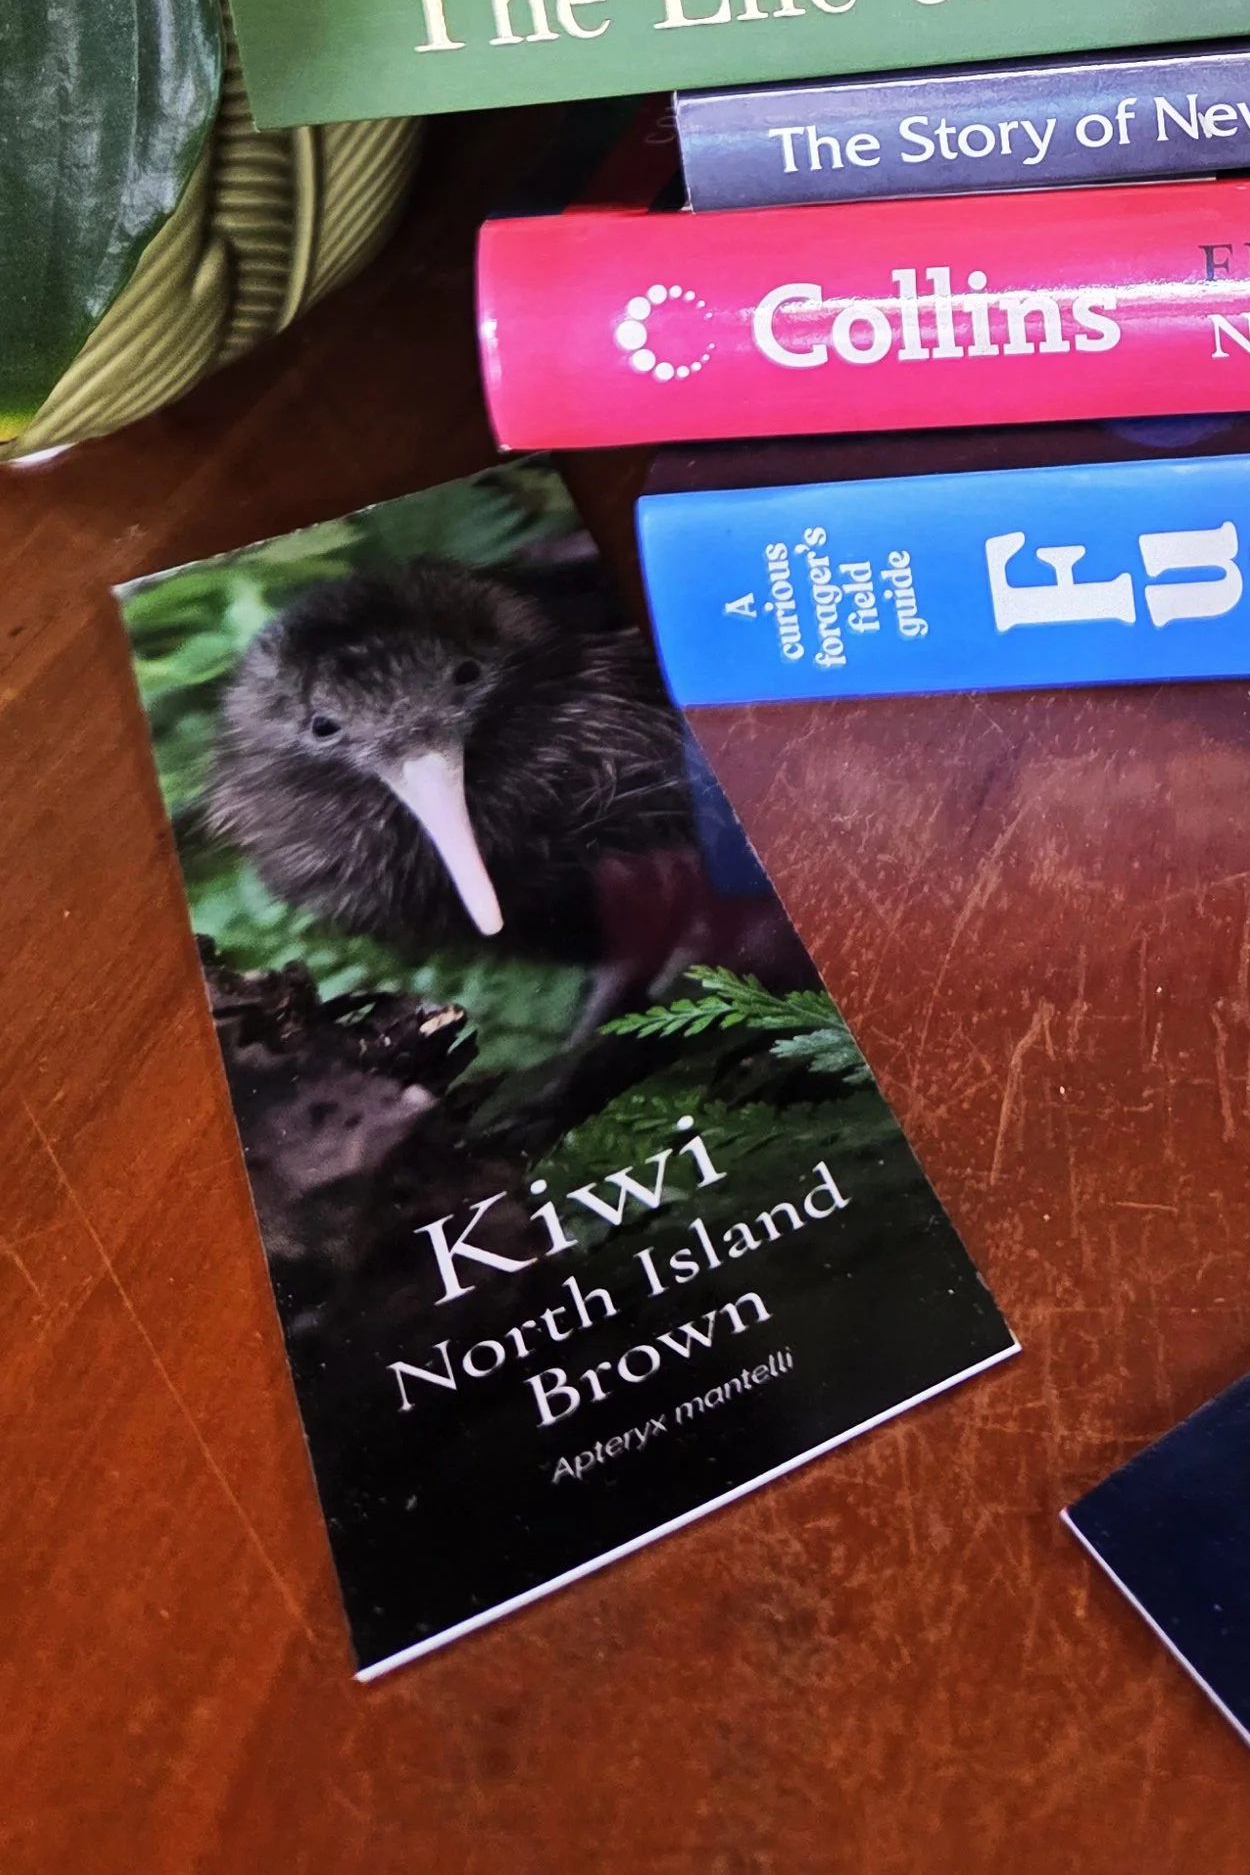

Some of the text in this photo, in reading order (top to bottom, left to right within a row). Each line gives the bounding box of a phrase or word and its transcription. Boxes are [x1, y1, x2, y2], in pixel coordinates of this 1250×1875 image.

[768, 124, 882, 173] The
[898, 115, 1057, 166] Story
[1075, 97, 1137, 148] of
[751, 266, 1122, 368] Collins
[724, 591, 758, 618] A
[764, 541, 805, 661] curious
[794, 525, 848, 668] forager's
[839, 560, 881, 633] field
[880, 549, 929, 638] guide
[413, 1114, 728, 1307] Kiwi
[385, 1160, 853, 1414] North Island
[523, 1290, 774, 1429] Brown
[550, 1345, 795, 1485] Apteryx mantelli
